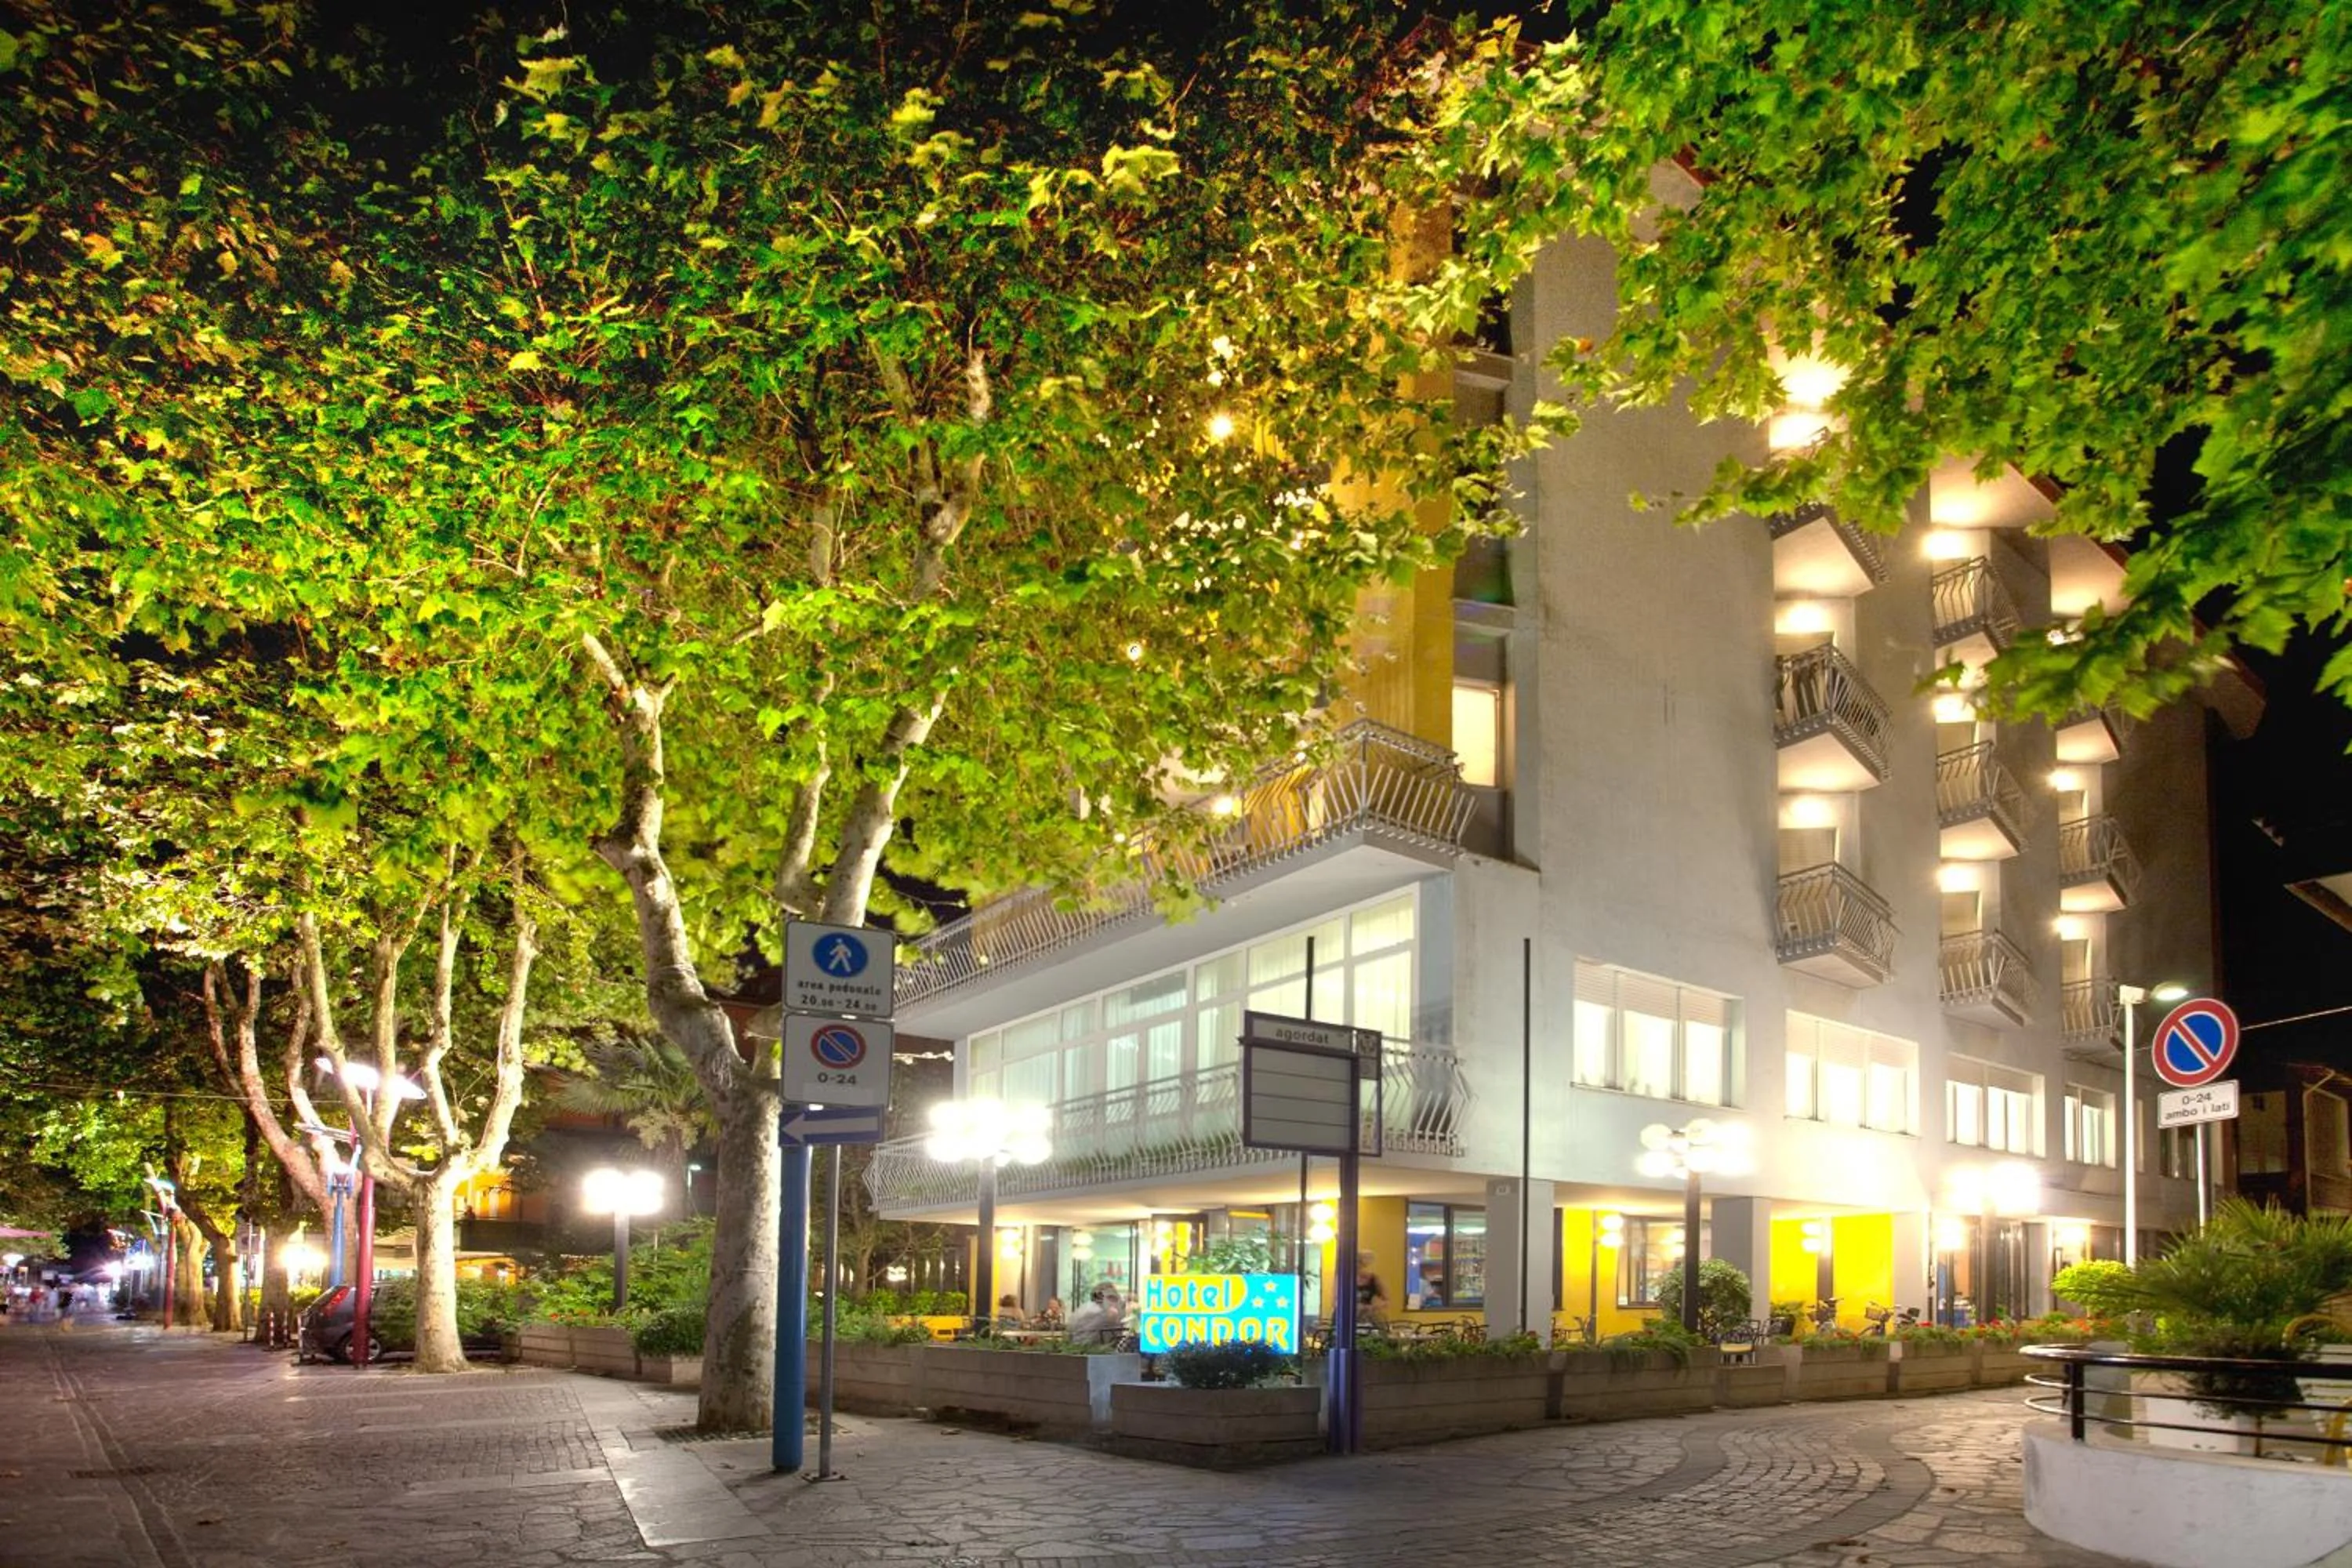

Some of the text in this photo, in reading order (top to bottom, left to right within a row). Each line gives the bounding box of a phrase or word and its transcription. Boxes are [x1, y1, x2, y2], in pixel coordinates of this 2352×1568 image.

[1275, 1028, 1329, 1044] agordat
[818, 1072, 856, 1085] 0-24
[2182, 1092, 2212, 1105] 0-24
[2165, 1108, 2198, 1120] ambo
[2212, 1102, 2230, 1112] lati
[1146, 1279, 1231, 1308] Hotel
[1145, 1316, 1290, 1349] CONDOR
